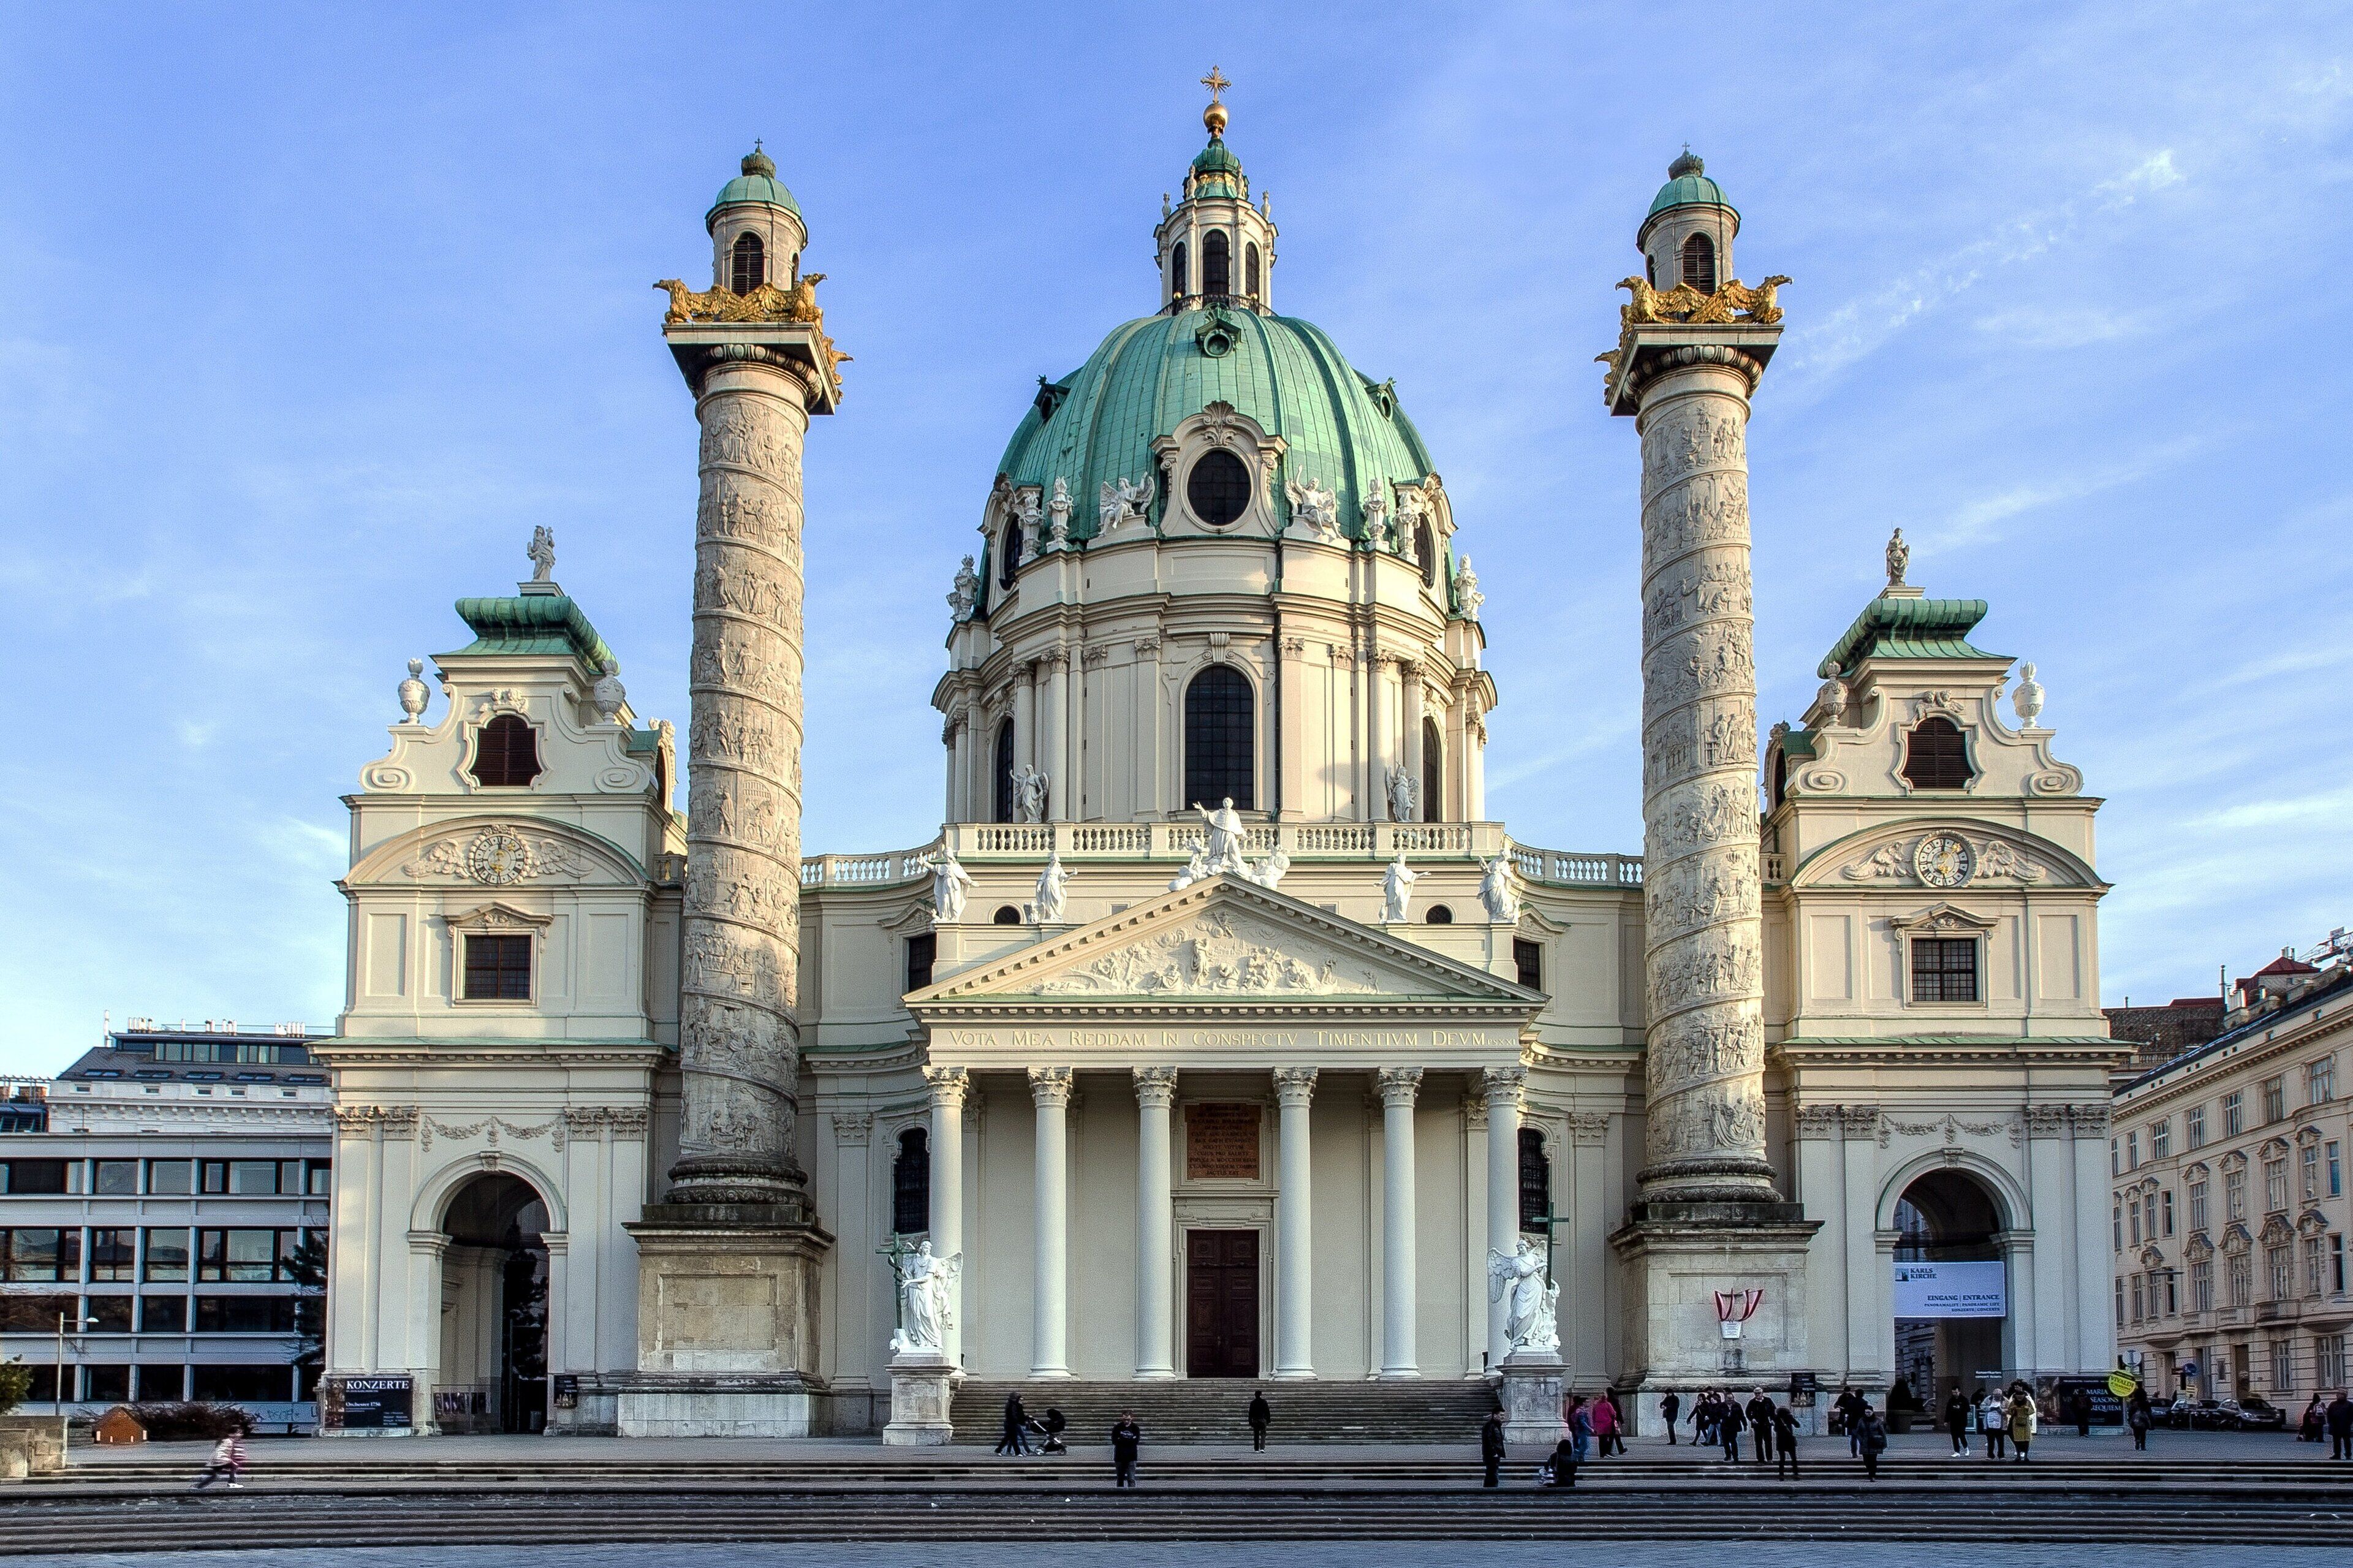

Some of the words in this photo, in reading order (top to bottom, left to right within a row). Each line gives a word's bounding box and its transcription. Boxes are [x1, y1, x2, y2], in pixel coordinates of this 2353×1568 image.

[949, 1031, 998, 1046] VOTA
[1012, 1031, 1055, 1046] MEA
[1070, 1031, 1147, 1046] REDDAM
[1161, 1031, 1178, 1046] IN
[1192, 1031, 1298, 1046] CONSPECTV
[1313, 1031, 1418, 1046] TIMENTIVM
[1431, 1031, 1485, 1046] DEVM
[346, 1380, 409, 1390] KONZERTE
